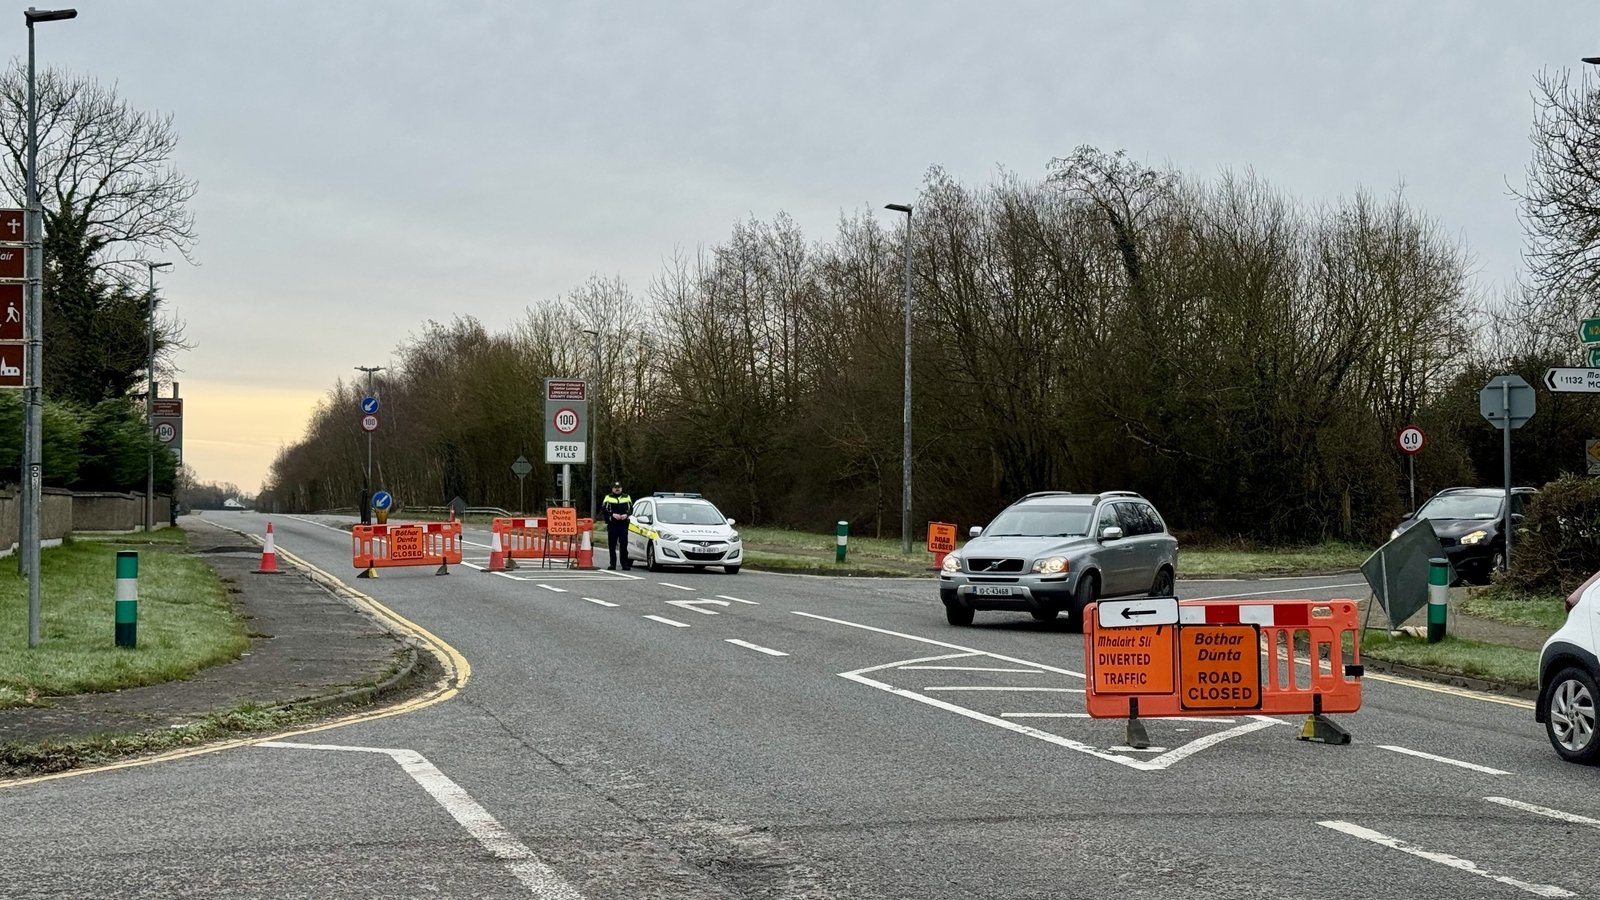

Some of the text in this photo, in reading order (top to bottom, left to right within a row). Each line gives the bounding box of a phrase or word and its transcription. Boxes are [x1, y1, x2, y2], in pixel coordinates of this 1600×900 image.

[0, 251, 14, 261] air
[365, 418, 376, 426] 100
[559, 414, 574, 426] 100
[1404, 433, 1417, 444] 60
[1098, 636, 1136, 647] Mhalairt
[1194, 633, 1243, 645] Bóthar
[1099, 653, 1151, 665] DIVERTED
[1198, 649, 1242, 661] Dúnta
[1104, 673, 1147, 684] TRAFFIC
[1199, 672, 1242, 684] ROAD
[1189, 687, 1252, 700] CLOSED
